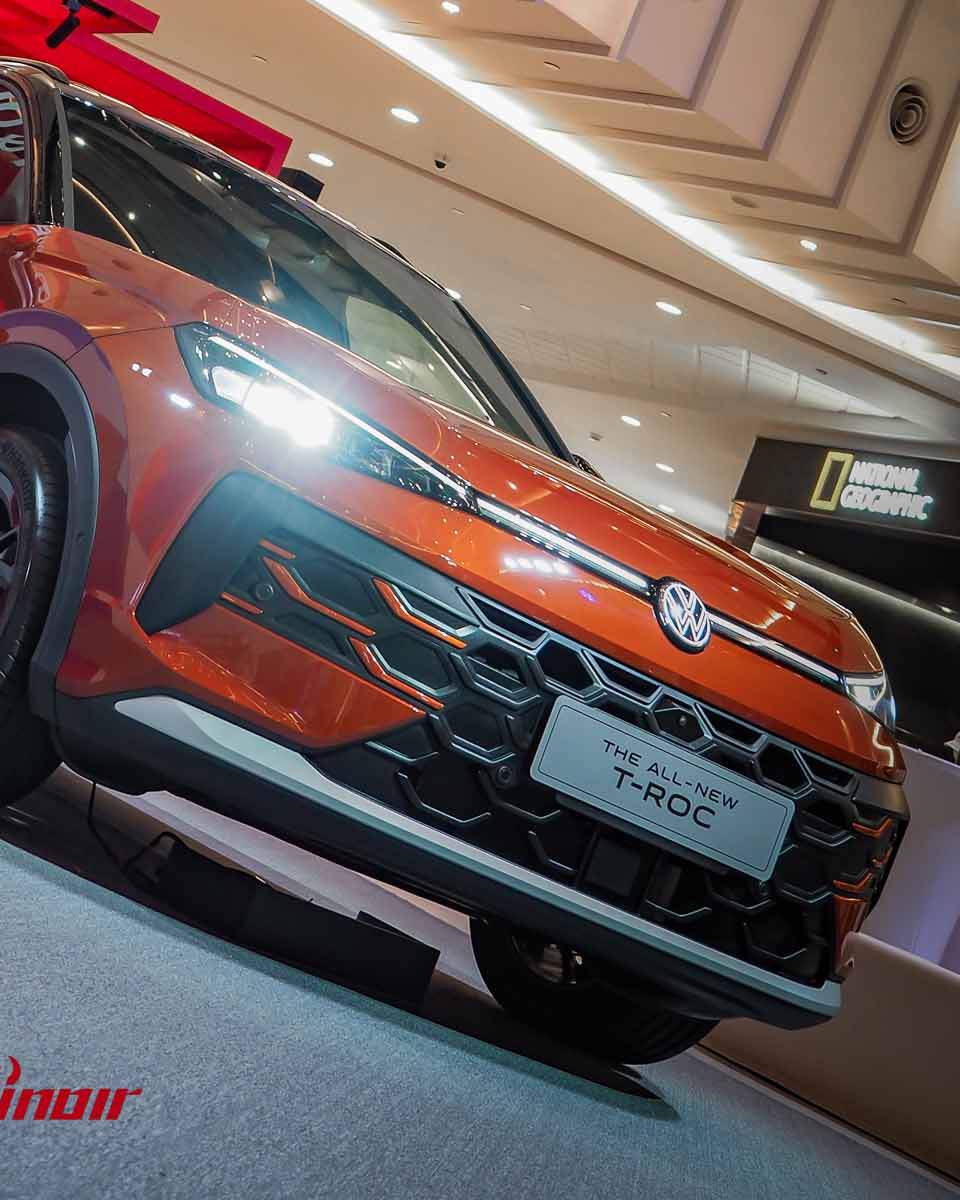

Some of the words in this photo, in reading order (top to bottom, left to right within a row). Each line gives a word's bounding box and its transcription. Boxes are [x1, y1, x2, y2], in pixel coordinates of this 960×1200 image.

[603, 738, 643, 767] THE
[647, 762, 739, 810] ALL-NEW
[613, 765, 717, 830] T-ROC
